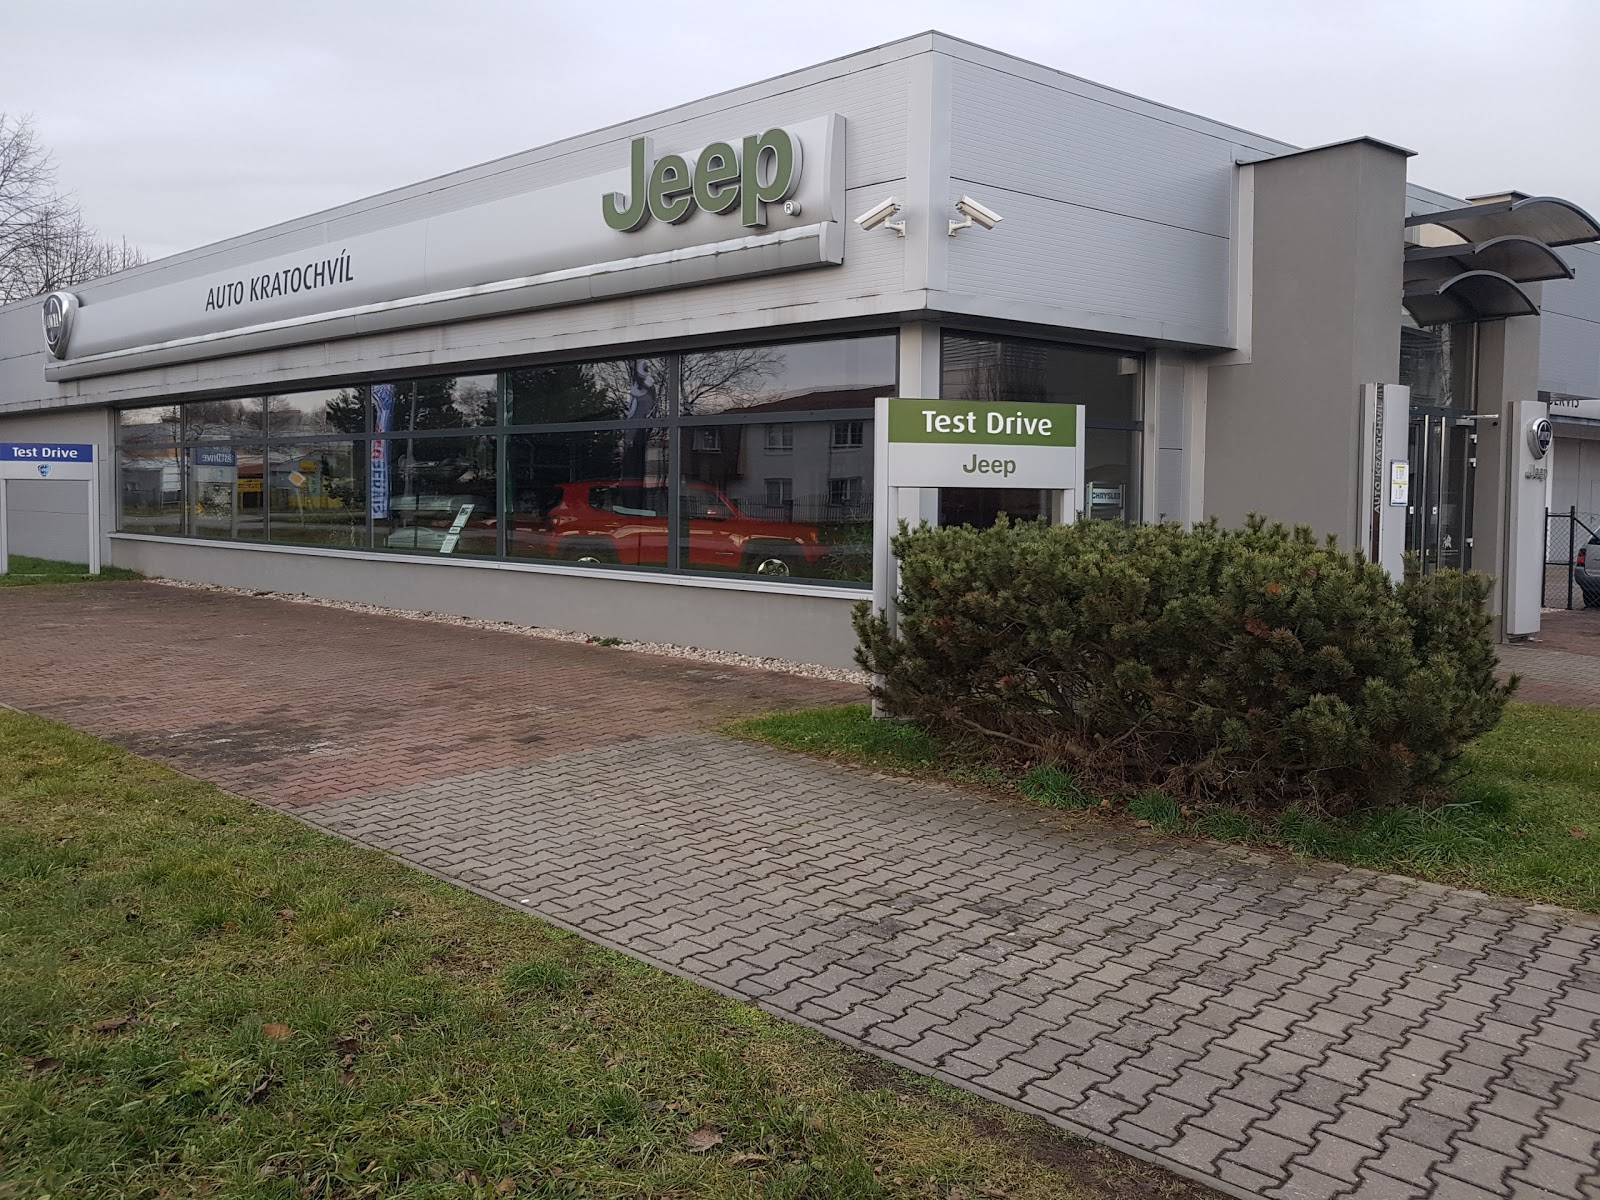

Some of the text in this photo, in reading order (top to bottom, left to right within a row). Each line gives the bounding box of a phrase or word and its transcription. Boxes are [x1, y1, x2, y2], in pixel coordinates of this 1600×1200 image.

[602, 127, 796, 232] Jeep
[205, 249, 354, 312] AUTO KRATOCHVÍL
[922, 410, 1053, 436] Test Drive
[12, 447, 78, 458] Test Drive
[963, 454, 1016, 477] Jeep
